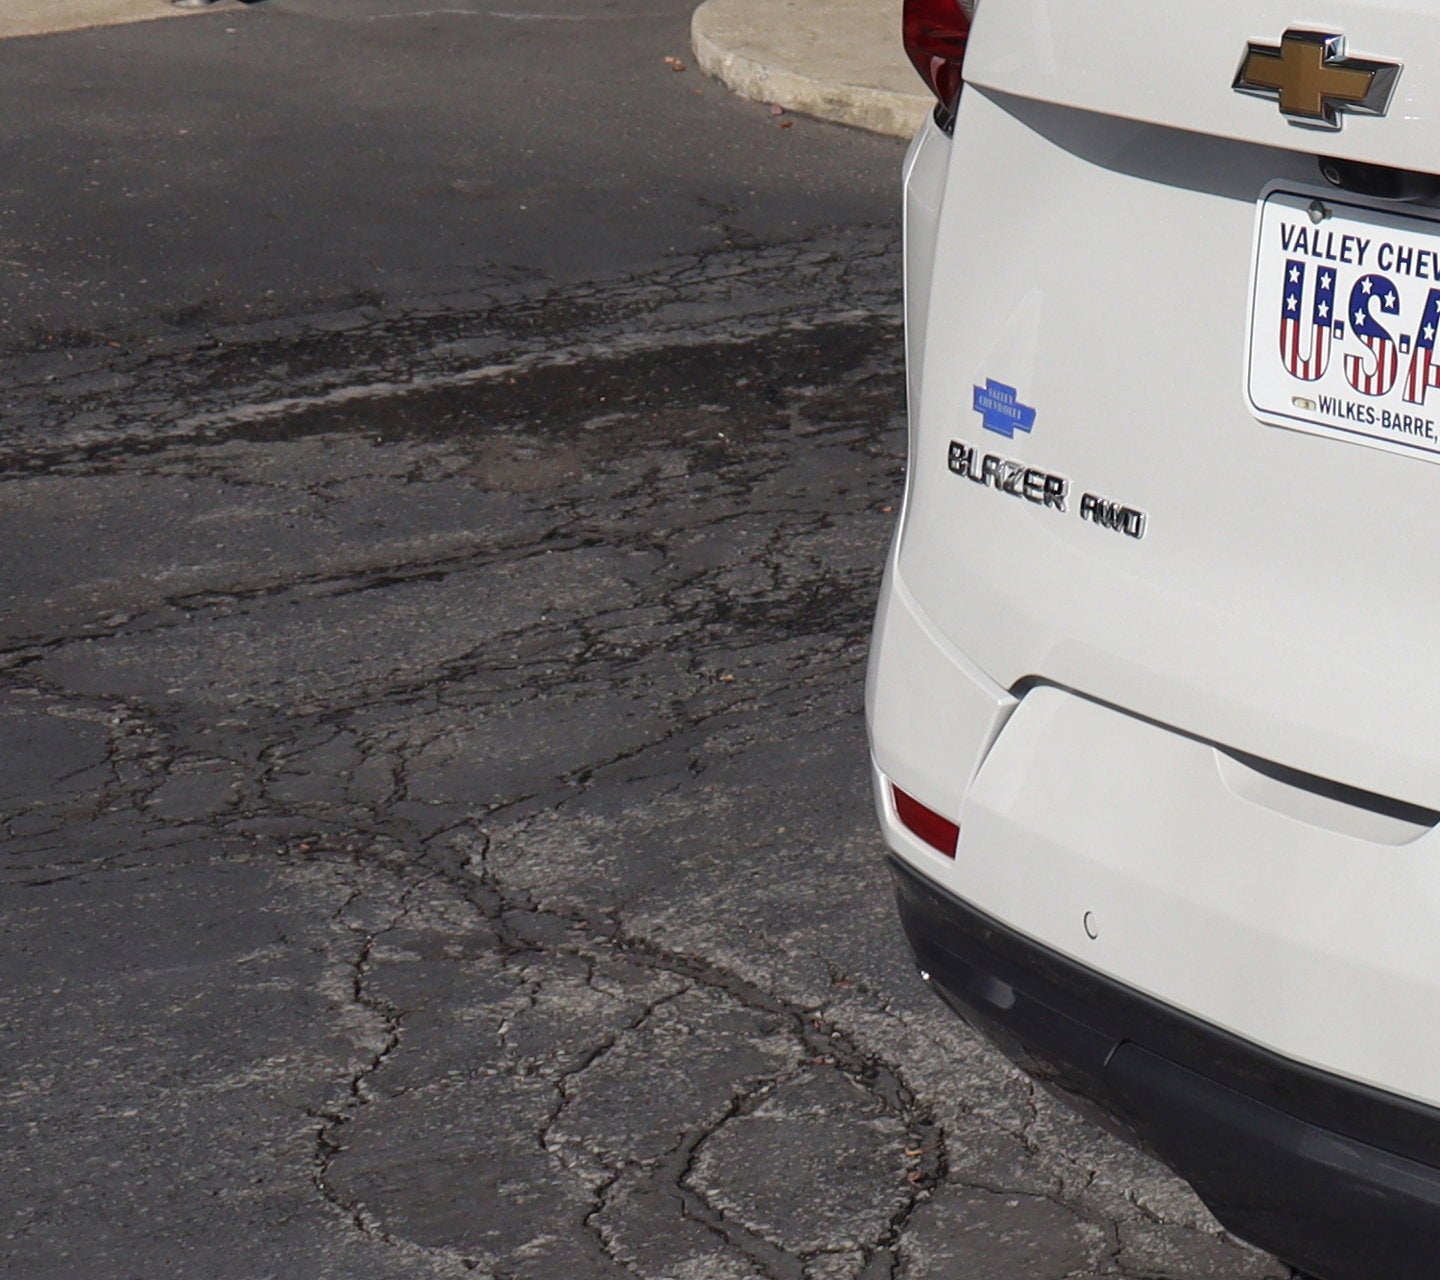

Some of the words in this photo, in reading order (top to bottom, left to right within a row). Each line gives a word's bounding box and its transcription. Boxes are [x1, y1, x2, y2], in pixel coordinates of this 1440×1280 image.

[1279, 222, 1371, 266] VALLEY
[1317, 393, 1439, 443] WILKES-BARRE,
[947, 439, 1071, 513] BLAZER
[1079, 492, 1148, 541] AWD
